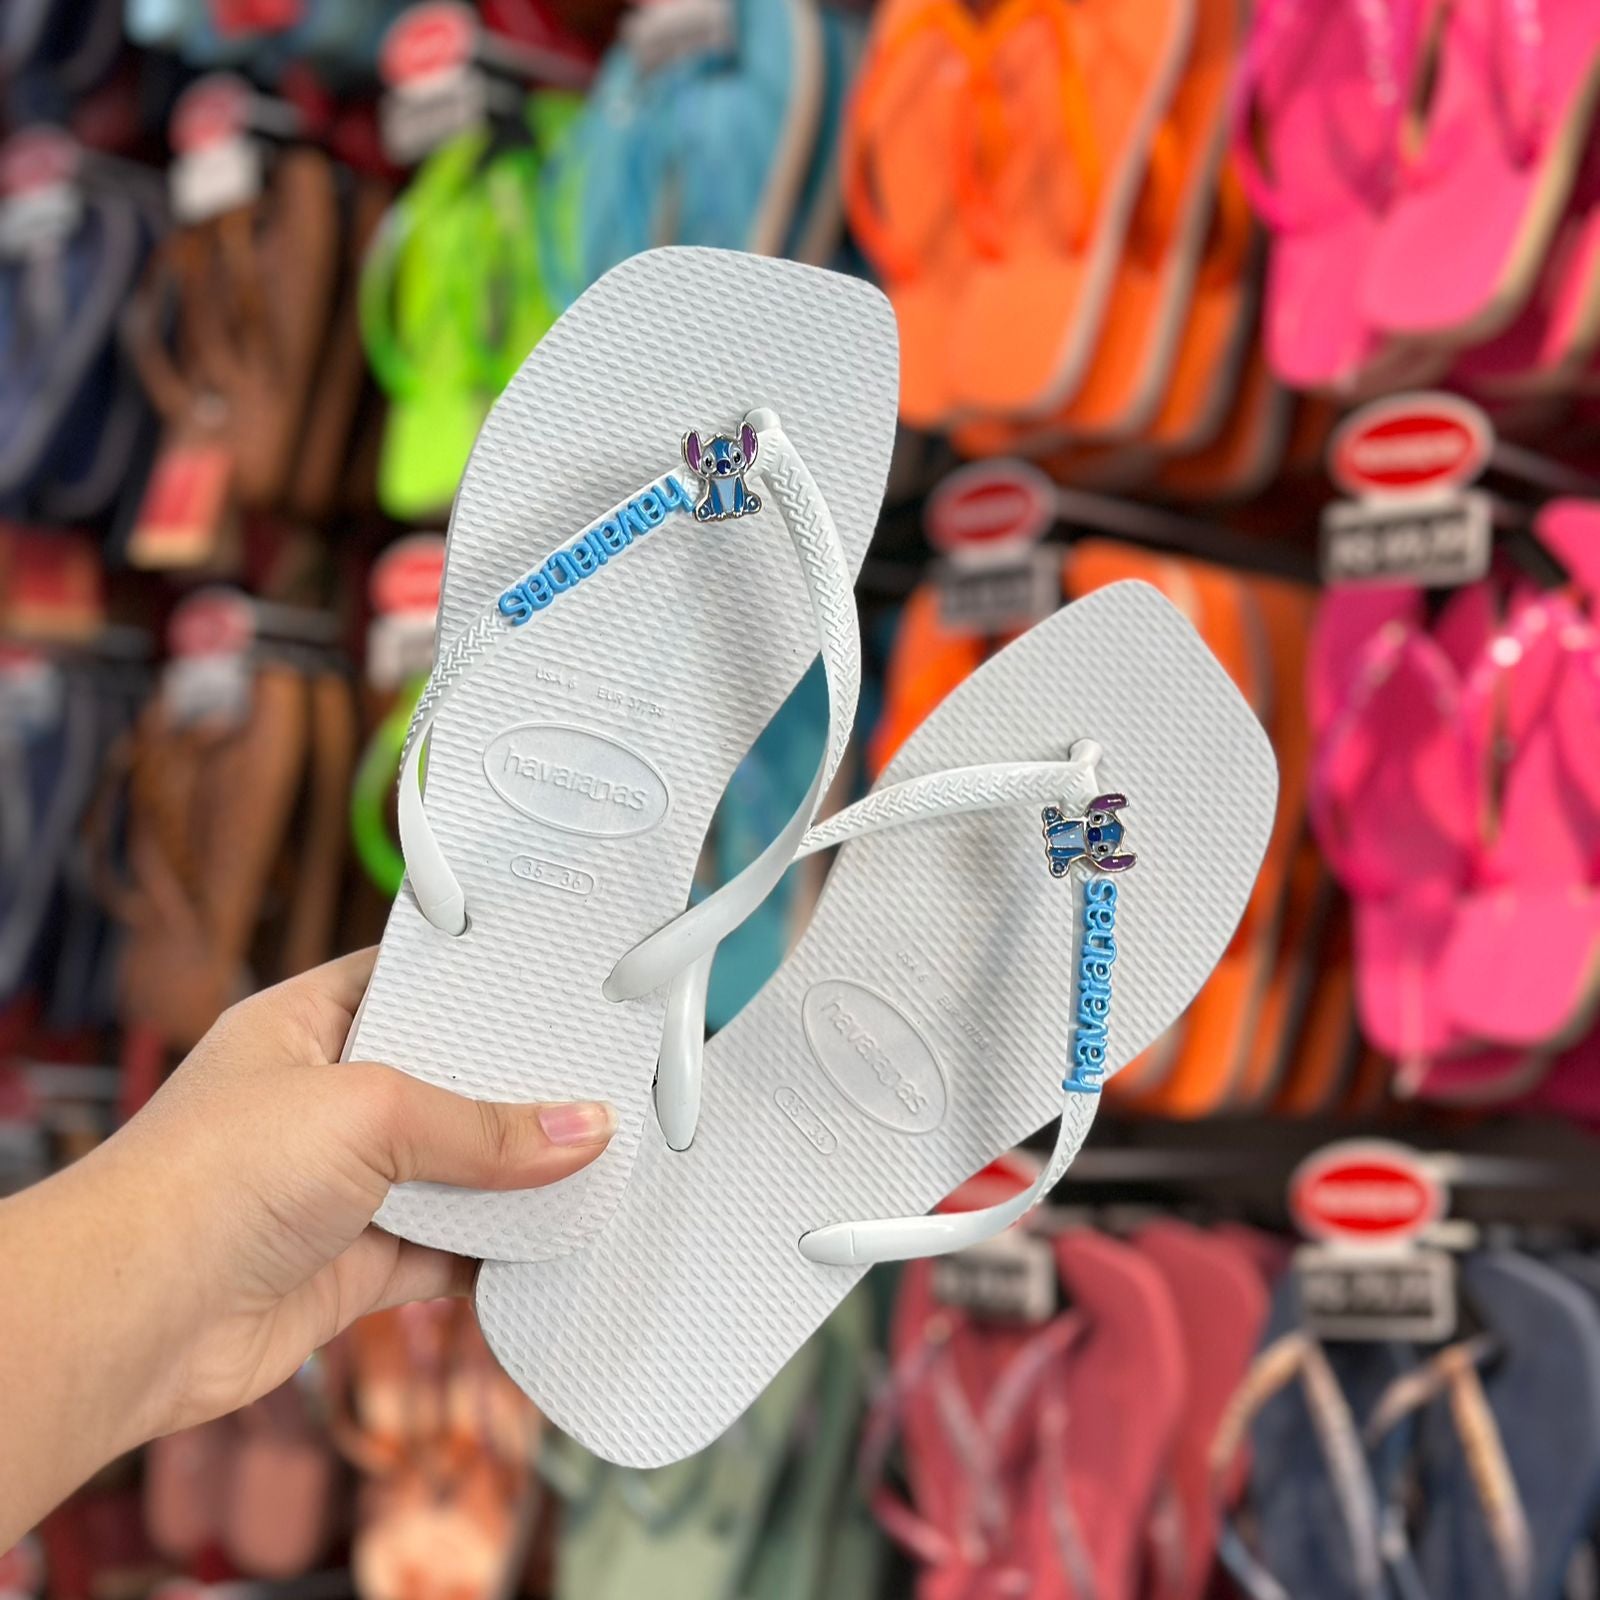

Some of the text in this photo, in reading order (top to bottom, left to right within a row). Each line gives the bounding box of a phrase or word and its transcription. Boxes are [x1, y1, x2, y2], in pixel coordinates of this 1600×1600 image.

[498, 474, 694, 627] havaianas
[503, 745, 650, 812] havaianas
[1061, 878, 1118, 1094] havaianas
